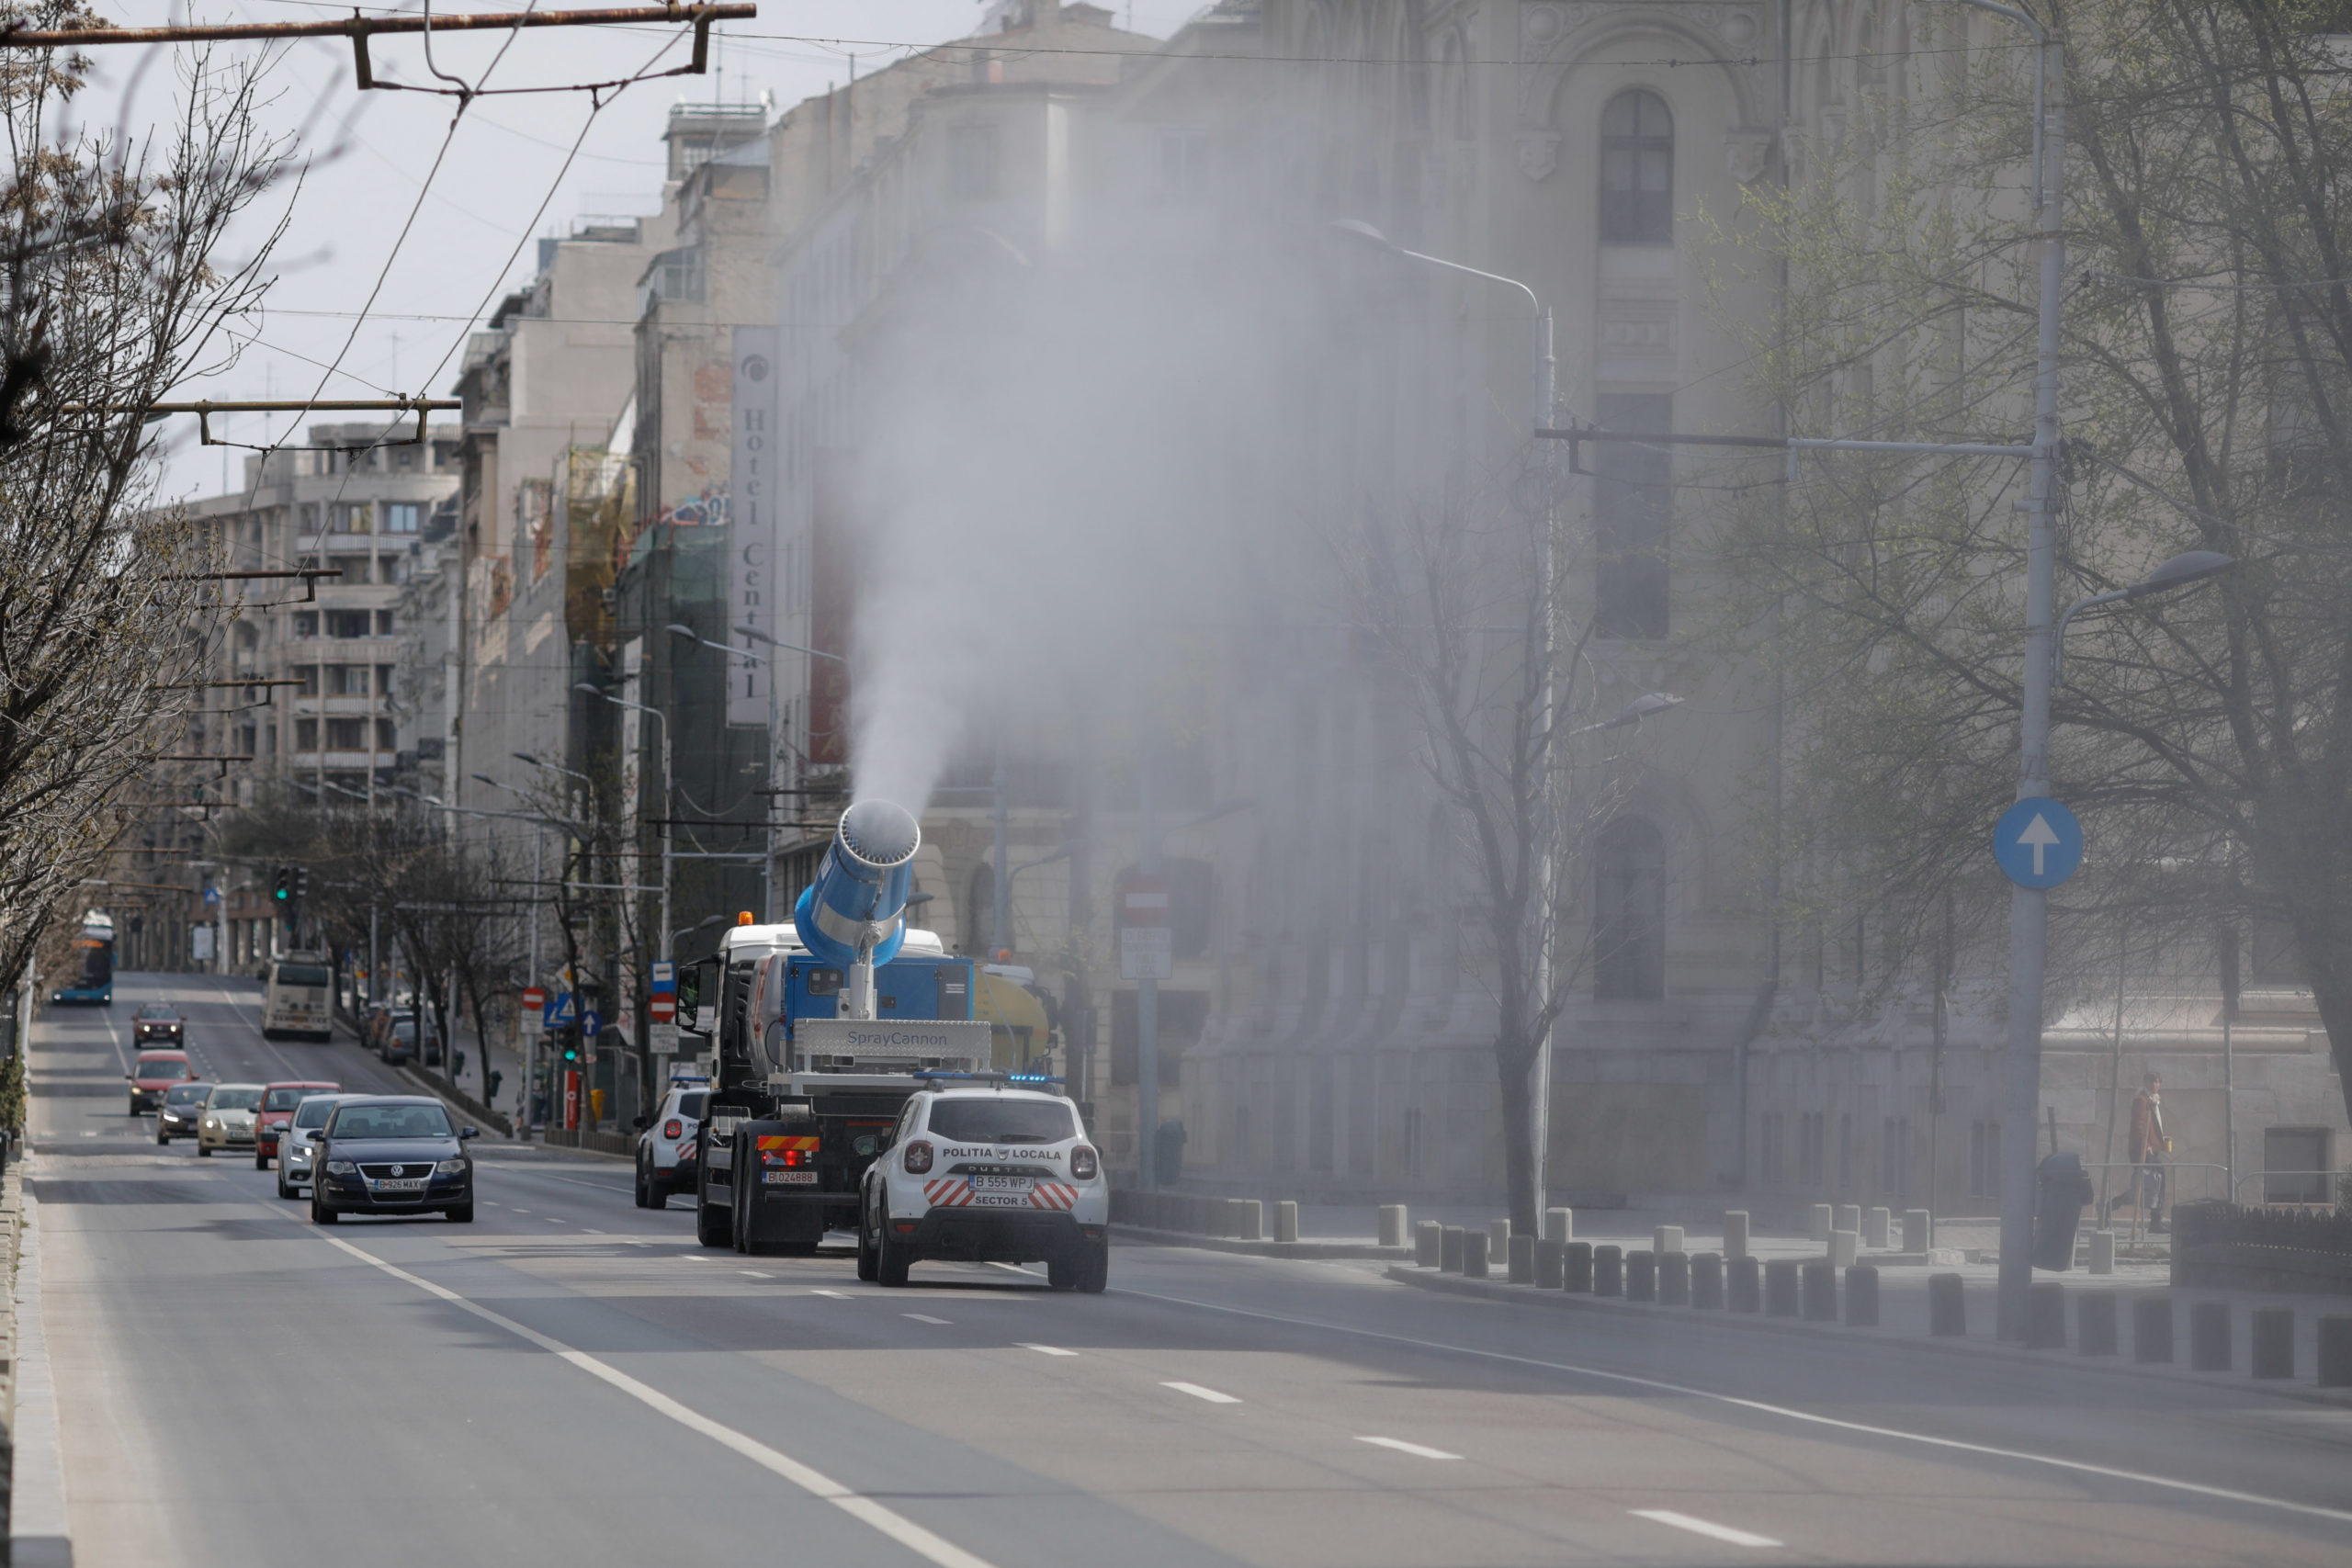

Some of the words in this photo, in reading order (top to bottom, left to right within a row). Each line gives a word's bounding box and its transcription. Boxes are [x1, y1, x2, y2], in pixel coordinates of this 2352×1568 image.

[744, 408, 765, 525] Hotel
[847, 1031, 948, 1046] SprayCannon
[943, 1148, 992, 1157] POLITIA
[1012, 1149, 1062, 1160] LOCALA
[976, 1176, 984, 1187] B
[988, 1177, 1008, 1188] 555
[975, 1197, 1019, 1206] SECTOR
[1021, 1198, 1028, 1206] 5
